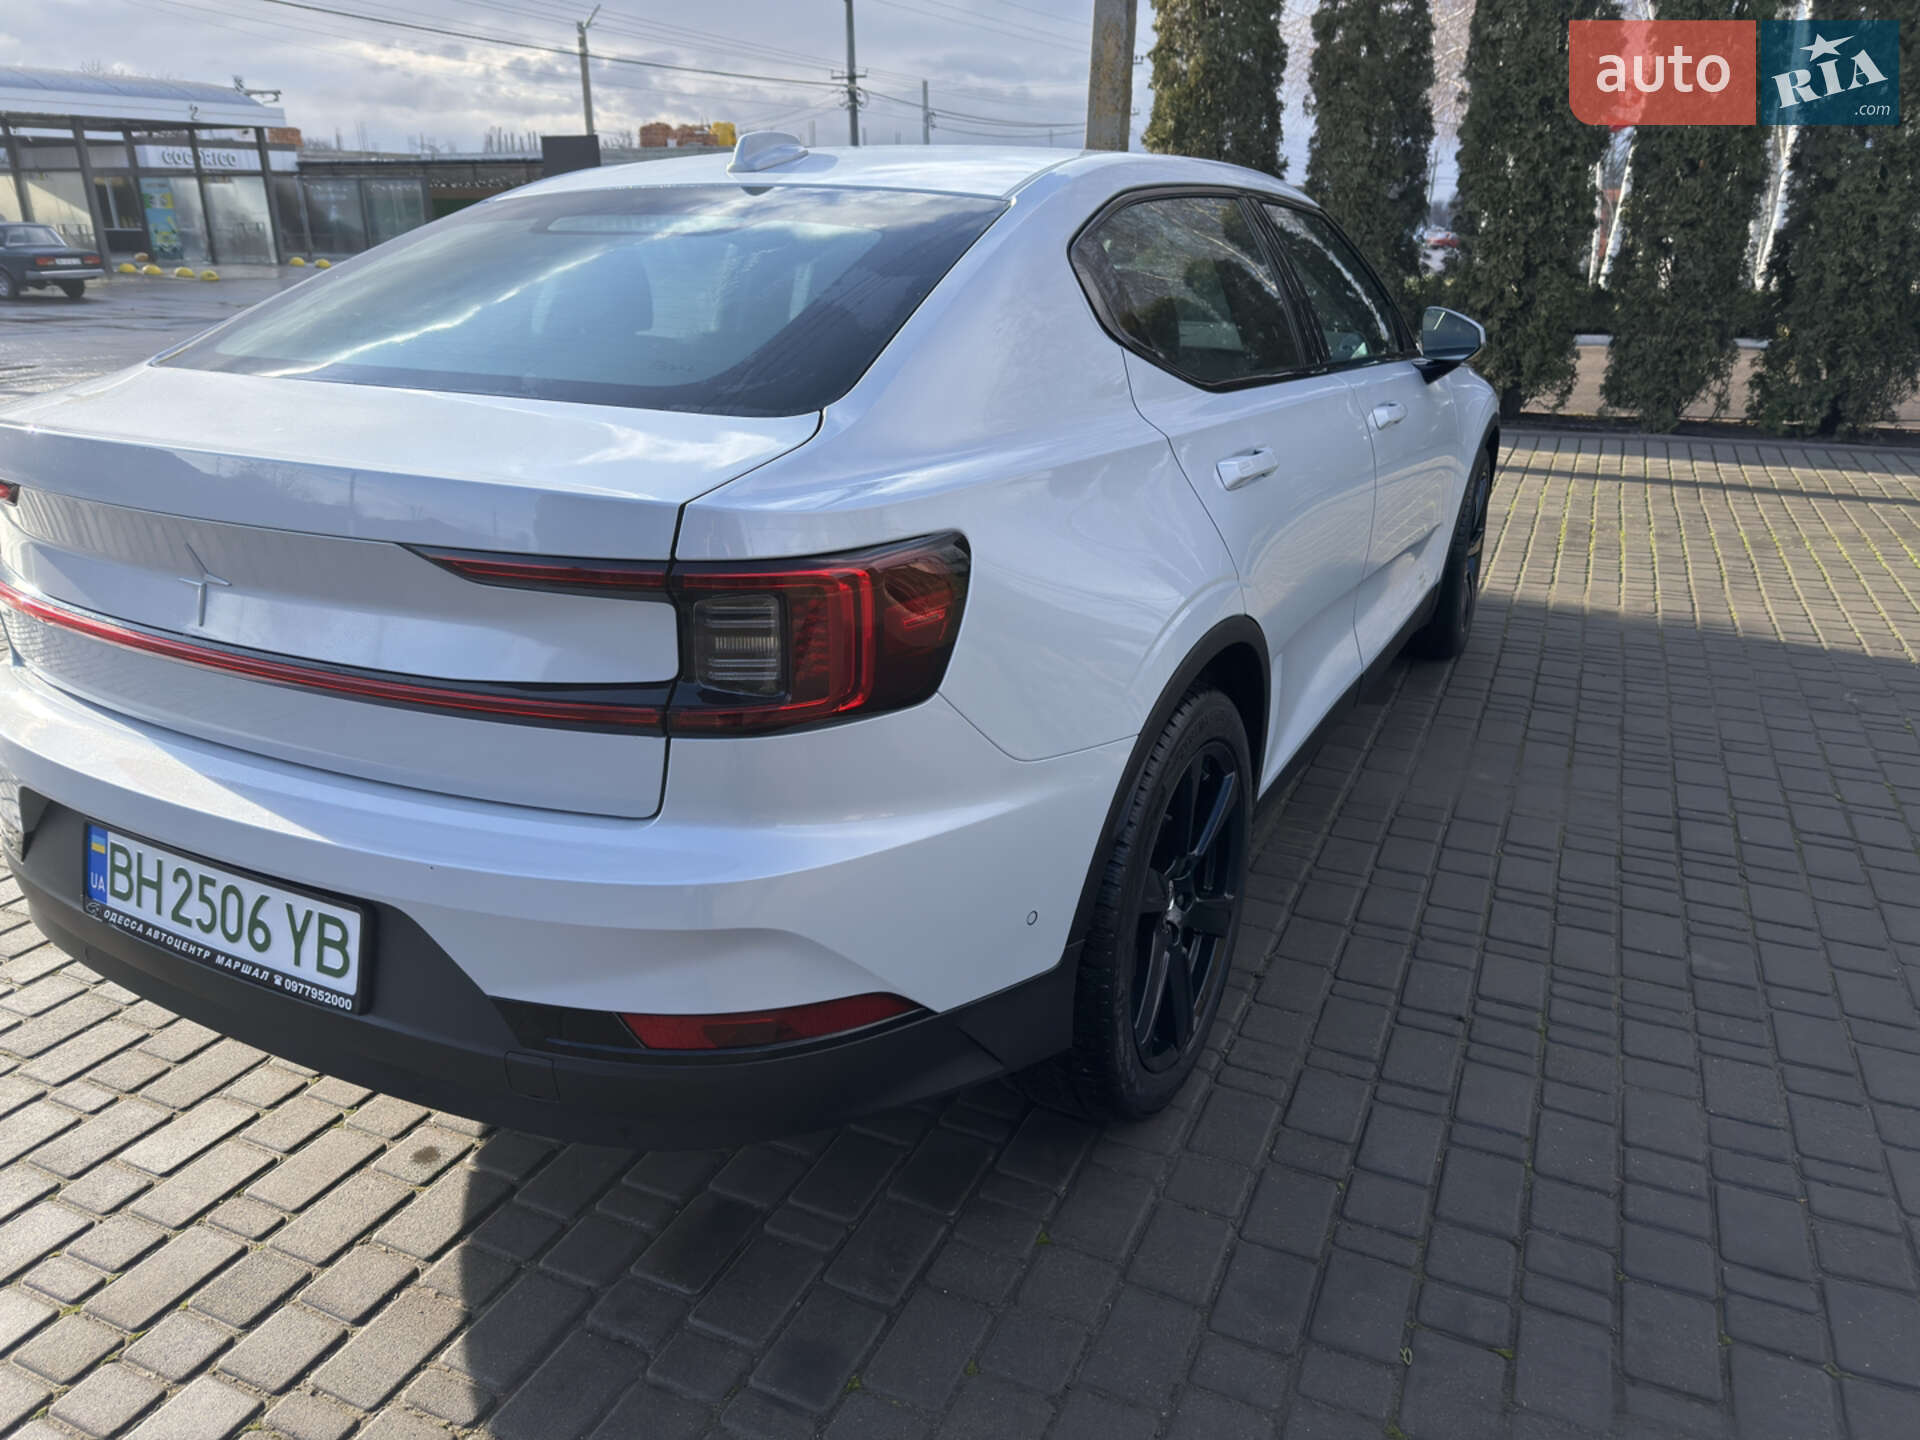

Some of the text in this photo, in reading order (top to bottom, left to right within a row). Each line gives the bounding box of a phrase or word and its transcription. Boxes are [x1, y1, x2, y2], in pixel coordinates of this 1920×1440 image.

[90, 872, 106, 894] UA
[109, 841, 351, 980] BH 2506 YB
[103, 910, 353, 1011] ОДЕССА АВТОЦЕНТР МАРШАЛ 0977952000
